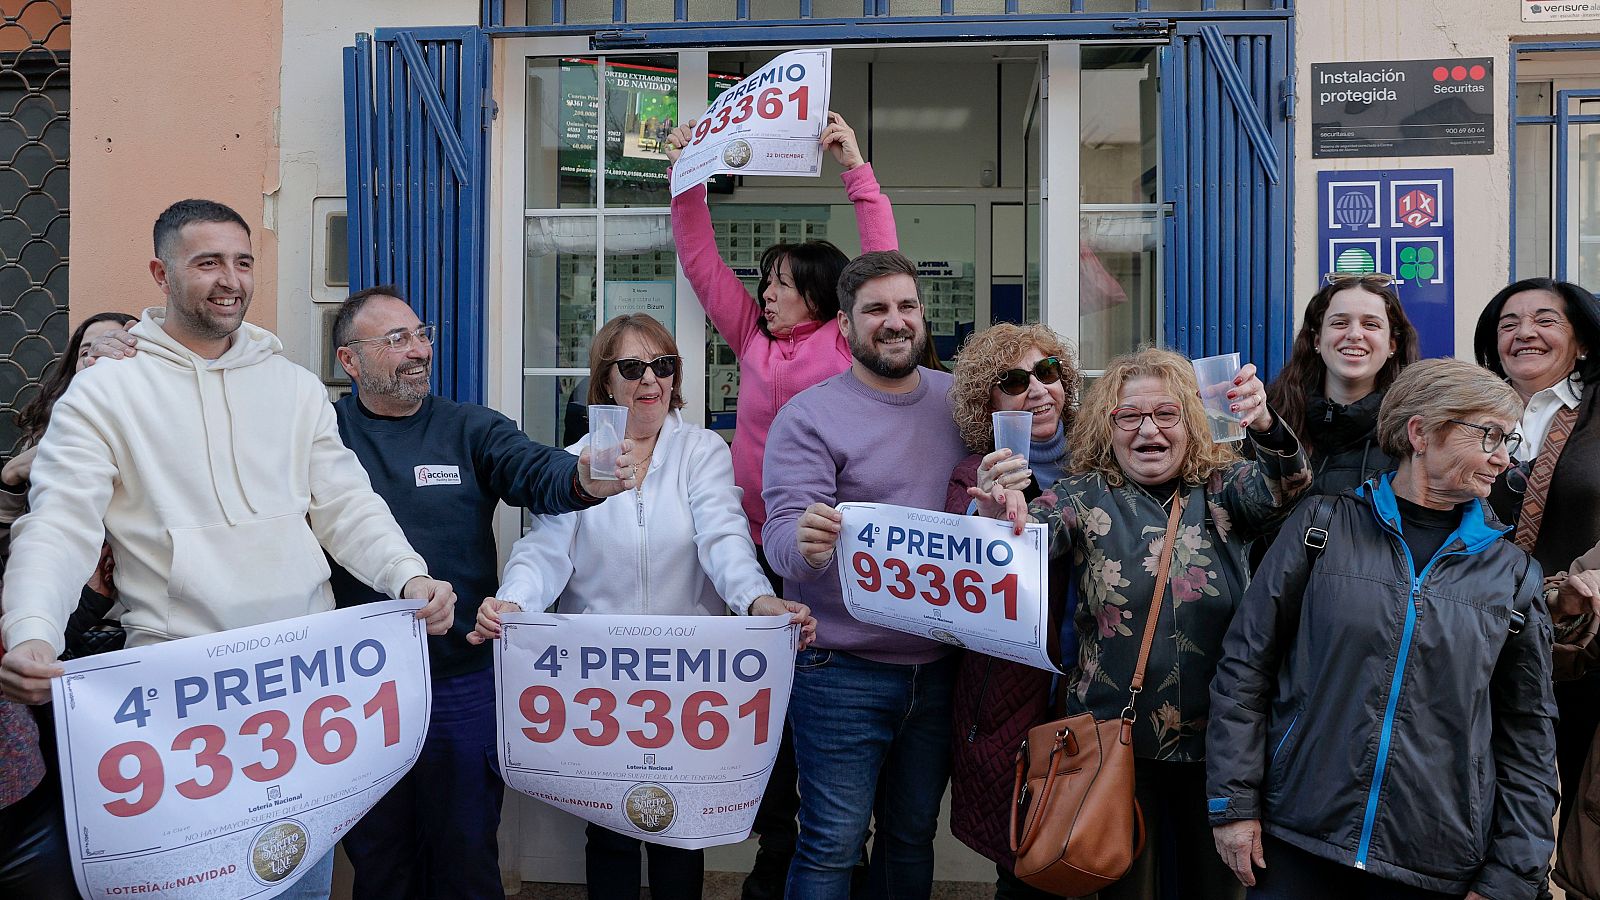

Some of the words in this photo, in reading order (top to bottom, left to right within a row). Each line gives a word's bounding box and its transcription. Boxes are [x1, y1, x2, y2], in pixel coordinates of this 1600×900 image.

[1544, 4, 1589, 12] verisure
[604, 71, 628, 79] ORTEO
[628, 73, 677, 84] EXTRAORDINA
[1320, 69, 1406, 84] Instalación
[617, 78, 630, 88] DE
[631, 80, 672, 92] NAVIDAD
[722, 63, 806, 107] PREMIO
[1433, 83, 1485, 94] Securitas
[1320, 87, 1397, 105] protegida
[692, 86, 809, 146] 93361
[427, 470, 458, 478] acciona
[906, 512, 940, 524] VENDIDO
[940, 518, 960, 526] AQUÍ
[886, 525, 1014, 567] PREMIO
[852, 551, 1019, 622] 93361
[607, 626, 663, 638] VENDIDO
[664, 625, 697, 638] AQUÍ
[206, 635, 271, 659] VENDIDO
[274, 626, 310, 646] AQUÍ
[580, 646, 768, 683] PREMIO
[174, 638, 387, 719] PREMIO
[518, 685, 772, 751] 93361
[97, 679, 401, 819] 93361
[602, 771, 626, 779] MAYOR
[274, 793, 303, 807] Nacional
[702, 807, 714, 815] 22
[184, 832, 198, 842] NO
[200, 827, 218, 838] HAY
[219, 818, 250, 832] MAYOR
[251, 810, 280, 824] SUERTE
